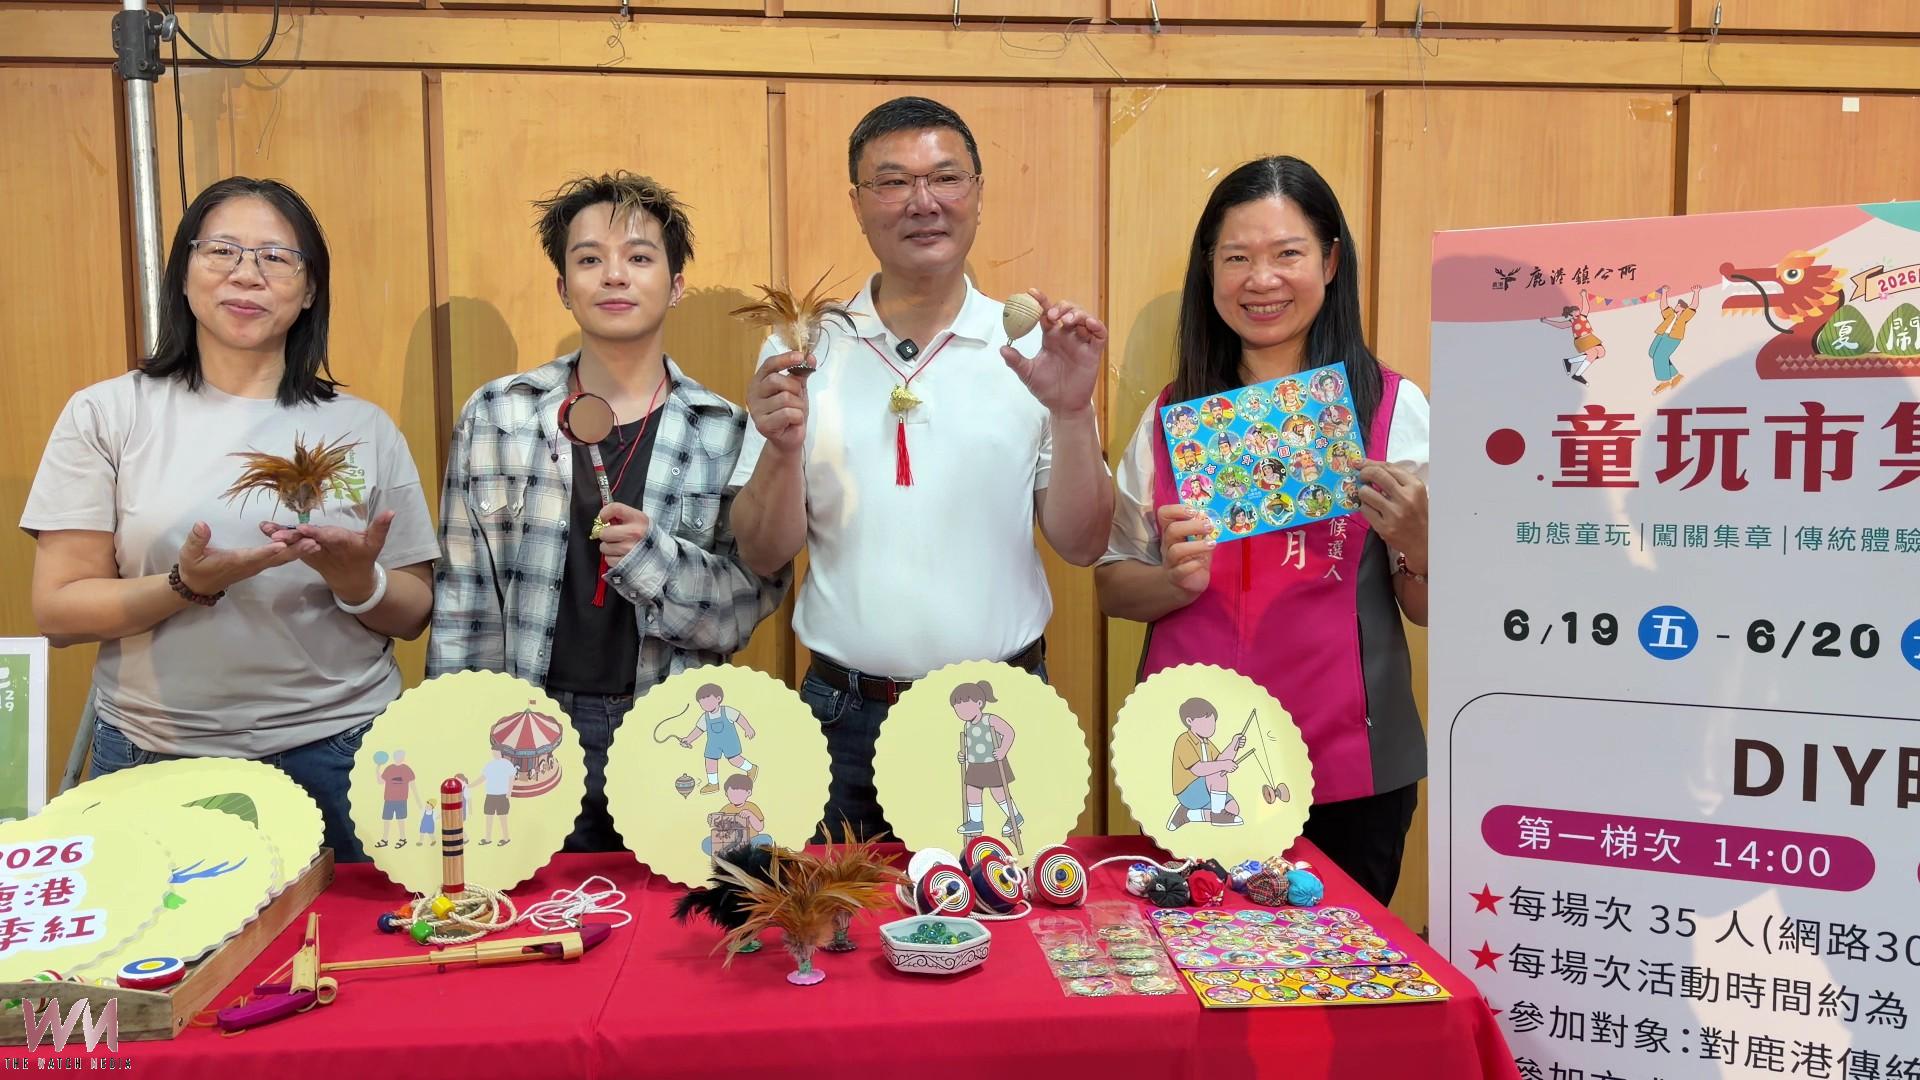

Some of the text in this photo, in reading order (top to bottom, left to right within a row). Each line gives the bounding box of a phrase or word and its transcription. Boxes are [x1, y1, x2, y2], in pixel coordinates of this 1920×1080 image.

[1526, 264, 1637, 289] 鹿港鎮公所
[1281, 529, 1306, 570] 月
[1504, 608, 1619, 646] 6/19
[1649, 614, 1688, 649] 五
[1746, 618, 1880, 659] 6/20
[0, 841, 83, 869] 026
[1516, 815, 1832, 877] 第一梯次 14:00
[1509, 885, 1633, 934] 每場次
[1648, 904, 1697, 938] 35
[1508, 942, 1908, 1030] 每場次活動時間約為
